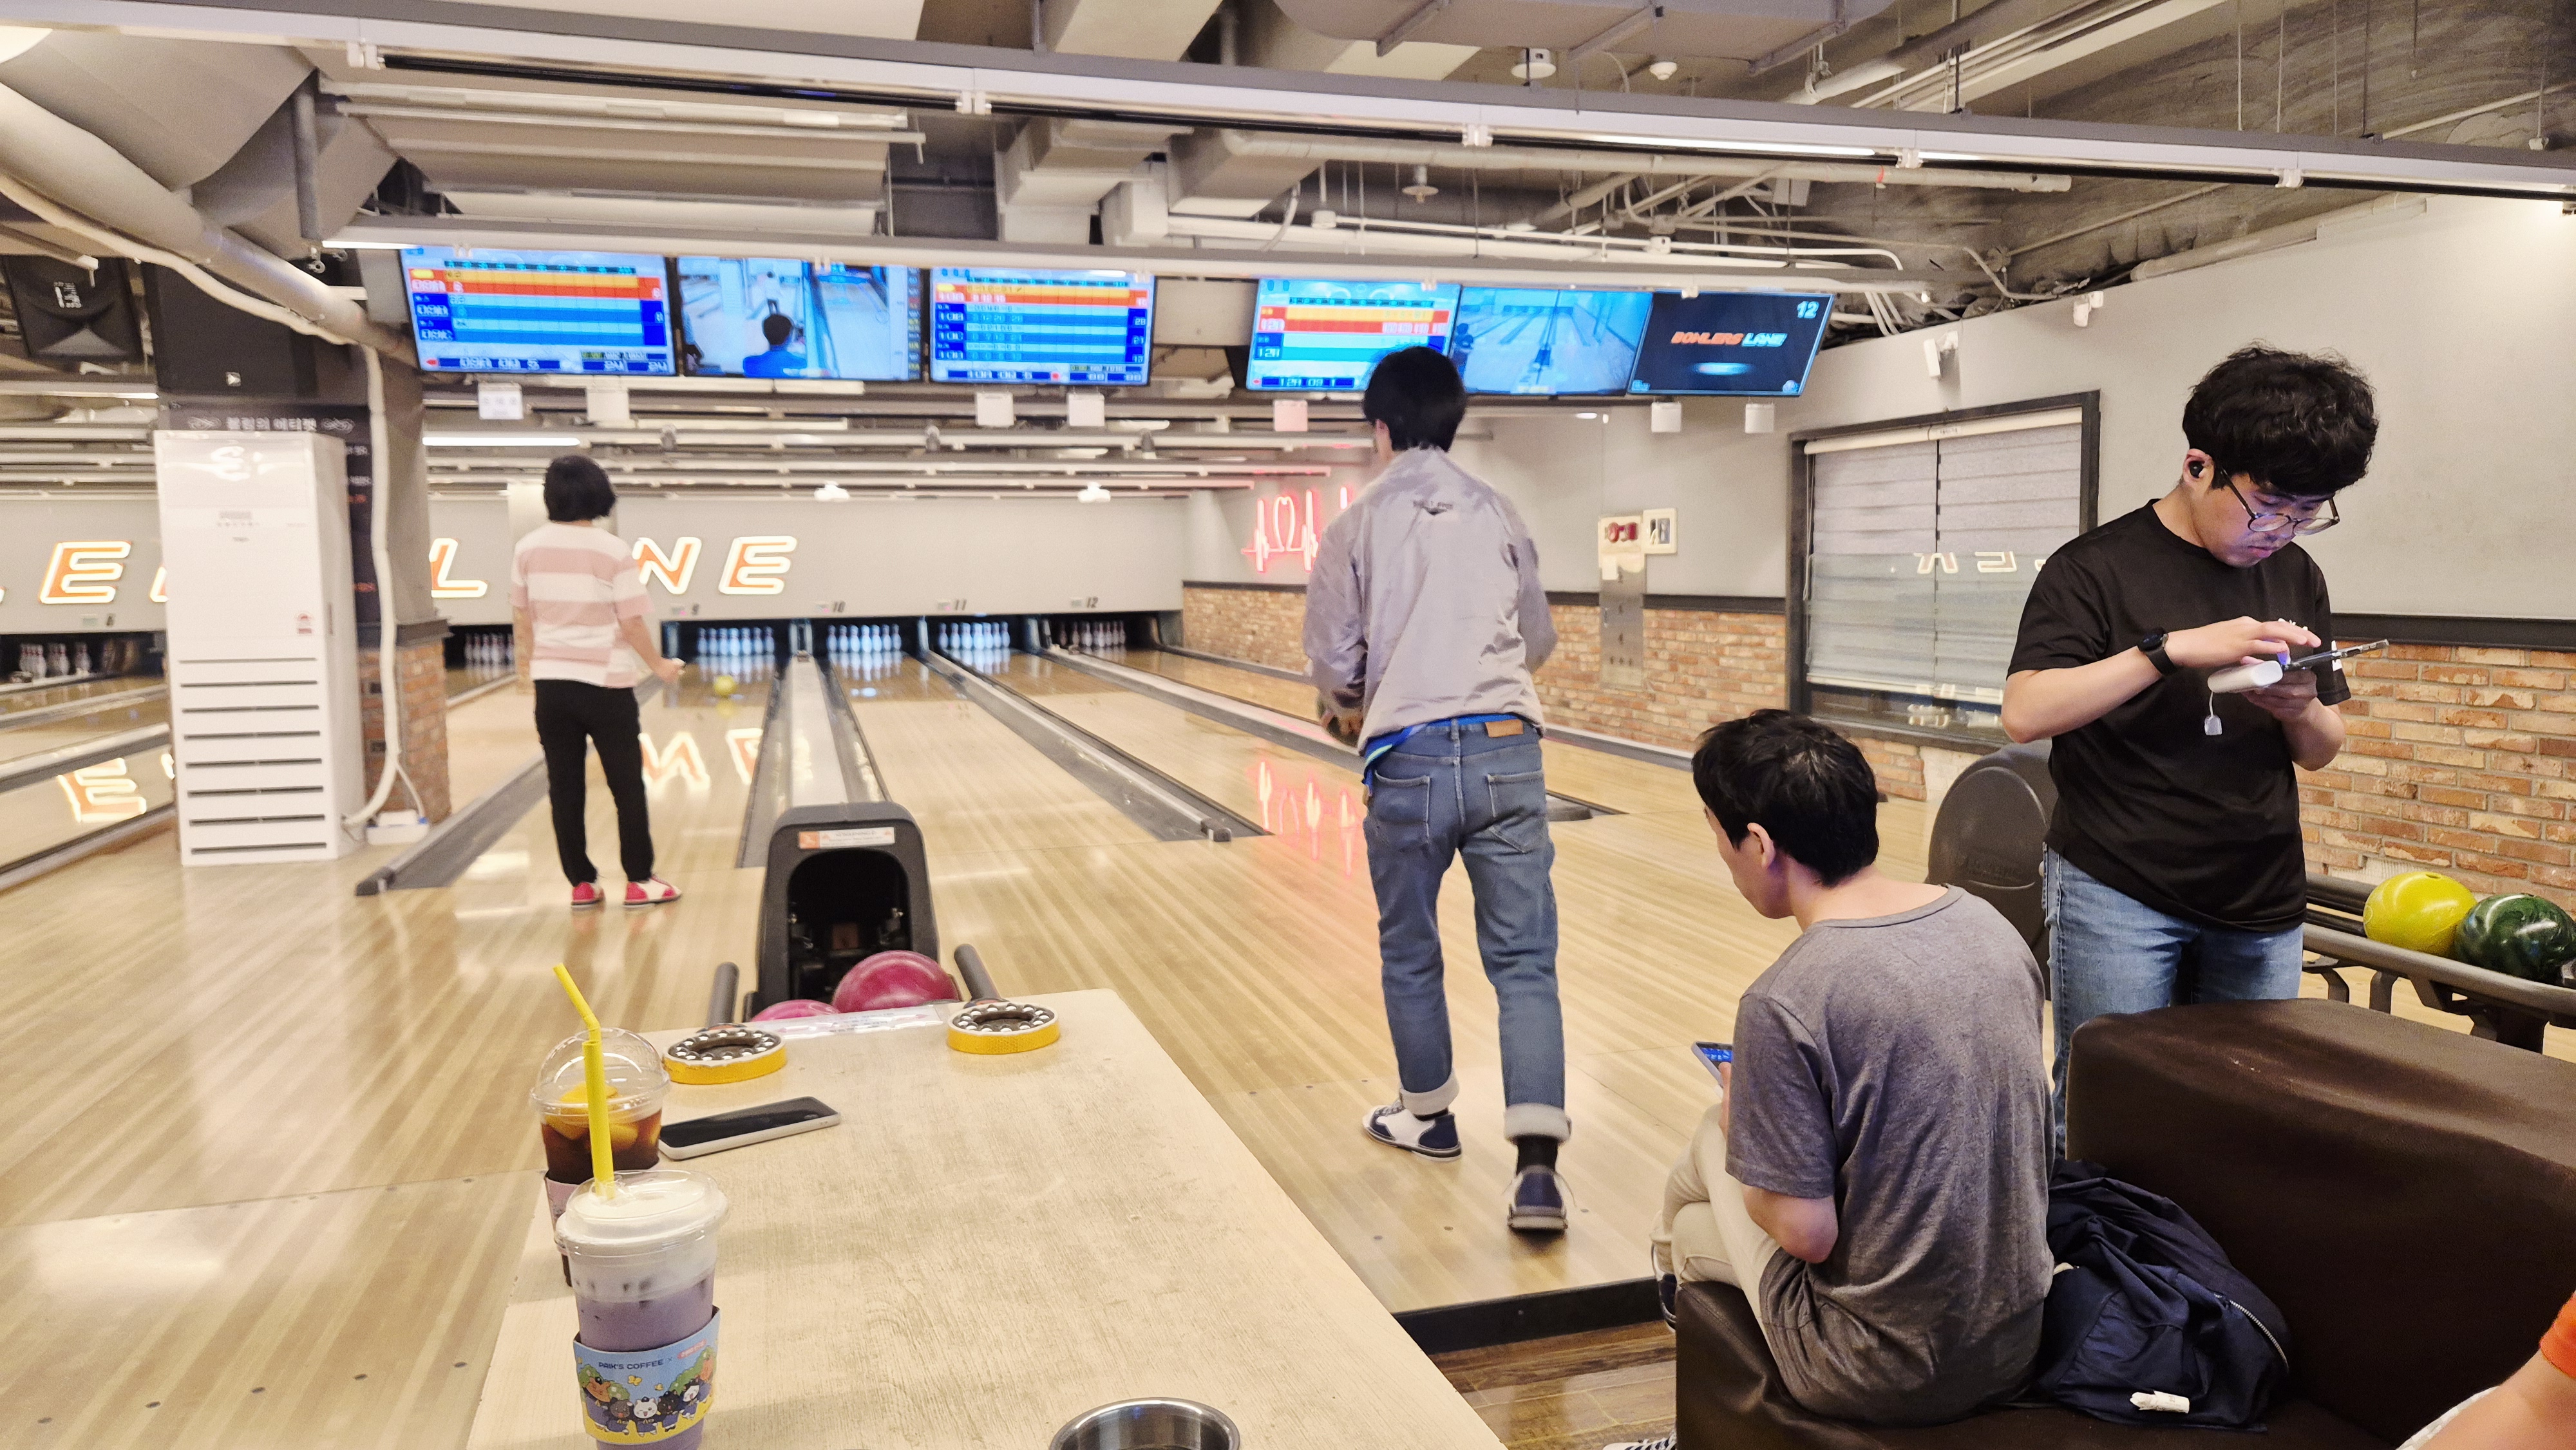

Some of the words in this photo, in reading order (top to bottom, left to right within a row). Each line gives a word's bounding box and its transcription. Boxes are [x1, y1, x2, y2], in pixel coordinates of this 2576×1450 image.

[1796, 301, 1820, 319] 12
[1741, 332, 1788, 348] LANE
[1086, 596, 1099, 608] 12
[627, 1359, 664, 1370] COFFEE
